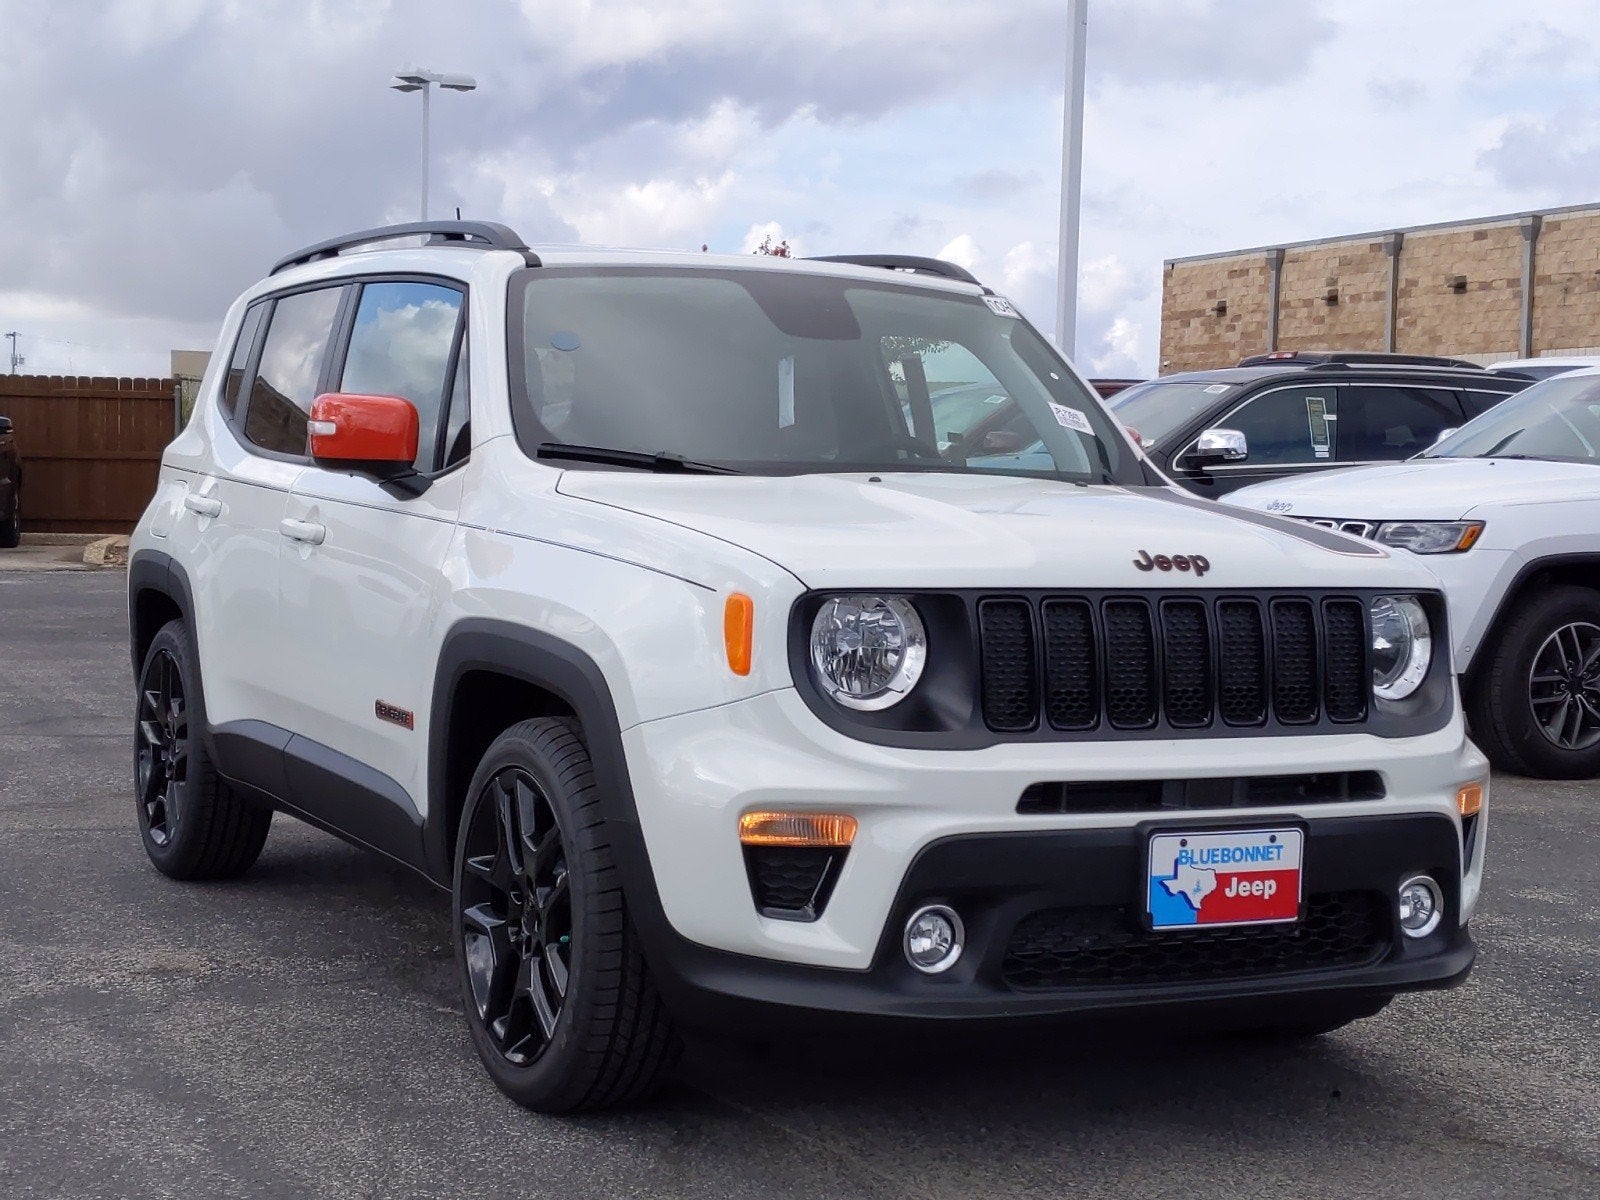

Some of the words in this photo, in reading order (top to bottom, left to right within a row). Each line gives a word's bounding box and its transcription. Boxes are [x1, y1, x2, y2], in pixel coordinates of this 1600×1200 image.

[1133, 549, 1210, 577] Jeep
[1178, 844, 1284, 866] BLUEBONNET
[1224, 876, 1277, 899] Jeep
